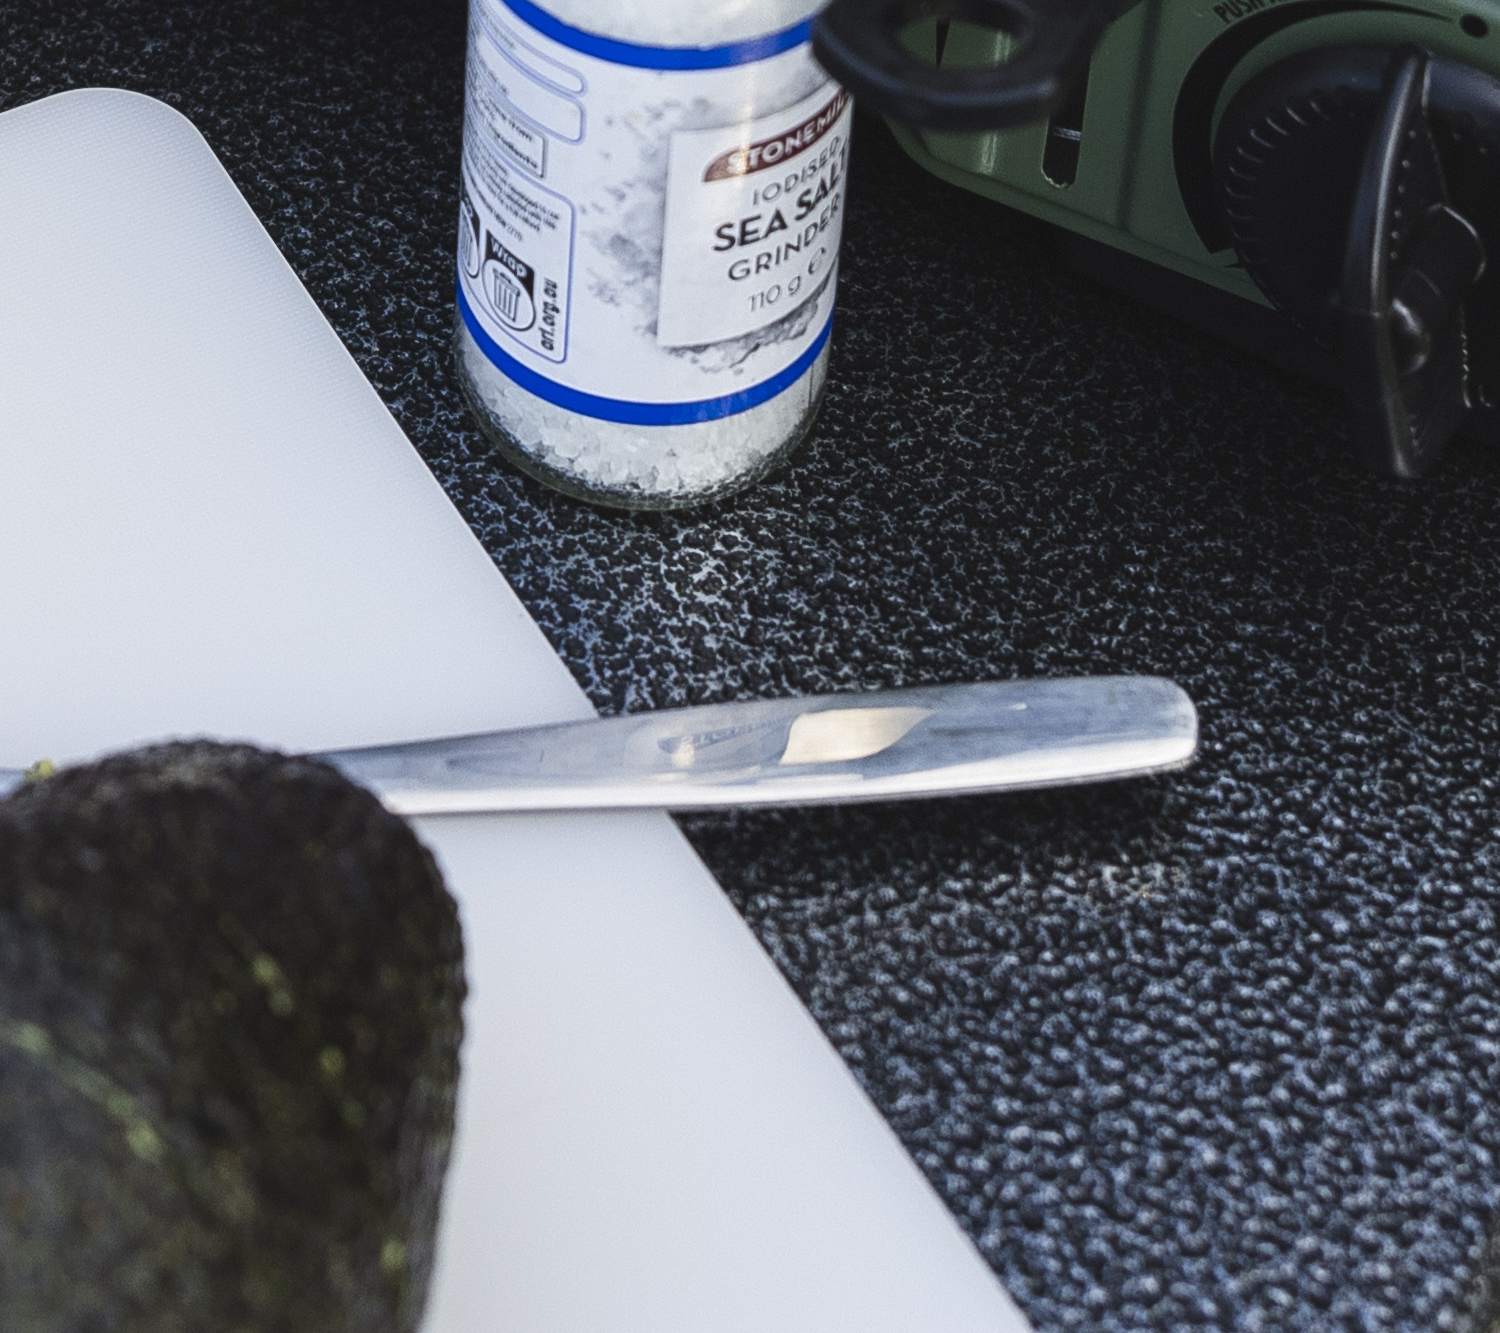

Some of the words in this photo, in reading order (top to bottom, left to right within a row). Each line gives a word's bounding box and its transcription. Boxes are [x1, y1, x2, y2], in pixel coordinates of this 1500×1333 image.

[713, 208, 788, 252] SEA
[795, 143, 848, 221] SALT
[753, 135, 842, 206] IODISED
[490, 237, 528, 279] Wrap
[728, 193, 841, 281] GRINDER
[749, 284, 781, 312] 110
[787, 275, 801, 296] g
